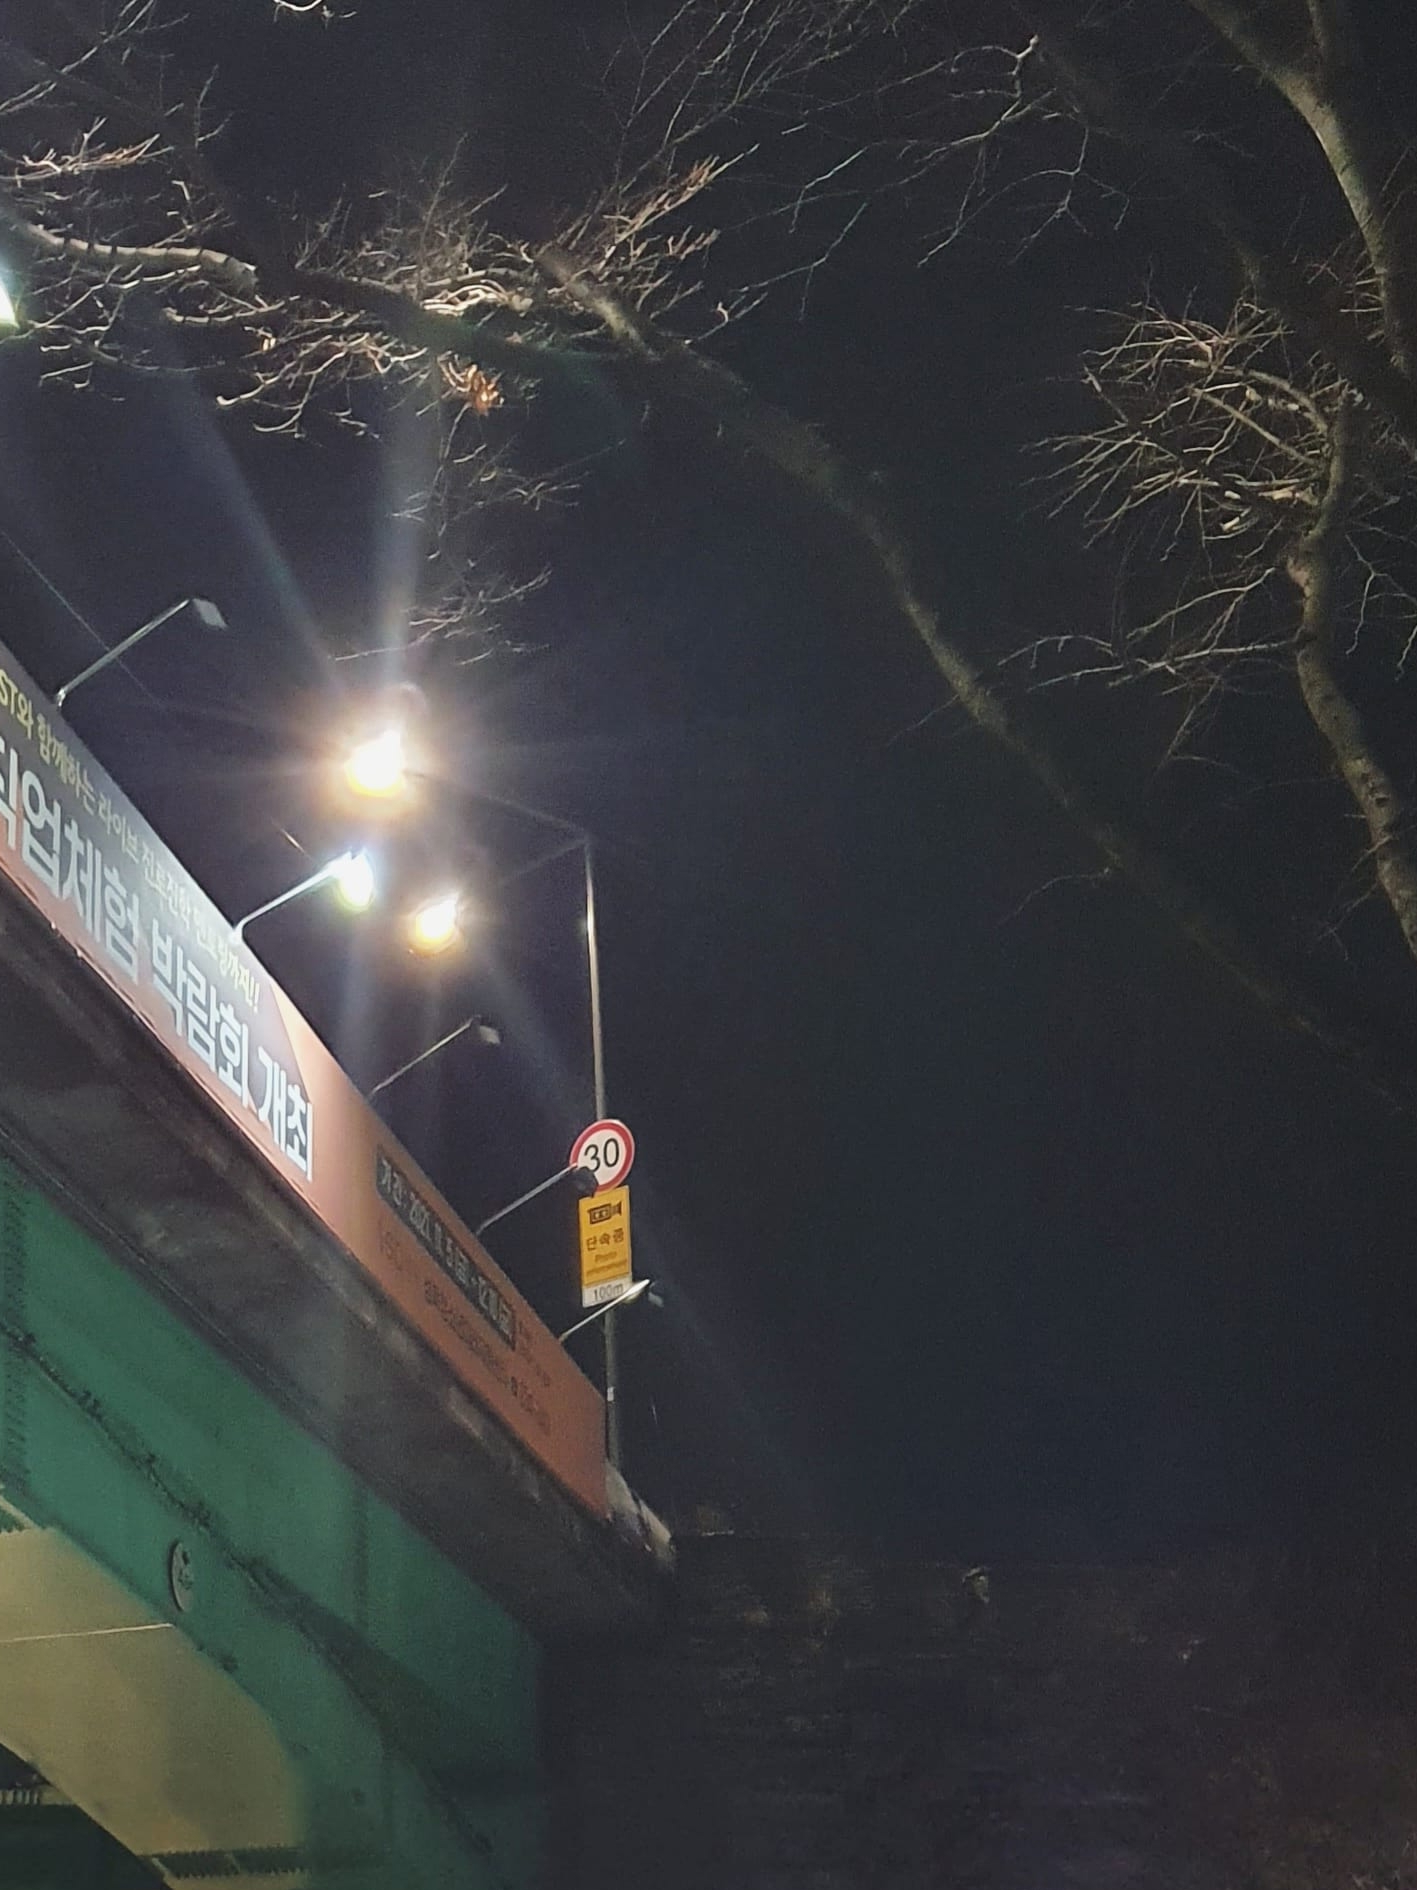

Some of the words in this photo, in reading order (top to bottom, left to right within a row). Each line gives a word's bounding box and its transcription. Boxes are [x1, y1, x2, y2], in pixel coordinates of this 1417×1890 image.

[37, 713, 95, 816] 함께하는
[99, 792, 139, 864] 라이브
[152, 918, 249, 1108] 박람회
[257, 1046, 313, 1182] 개최
[584, 1138, 619, 1172] 30
